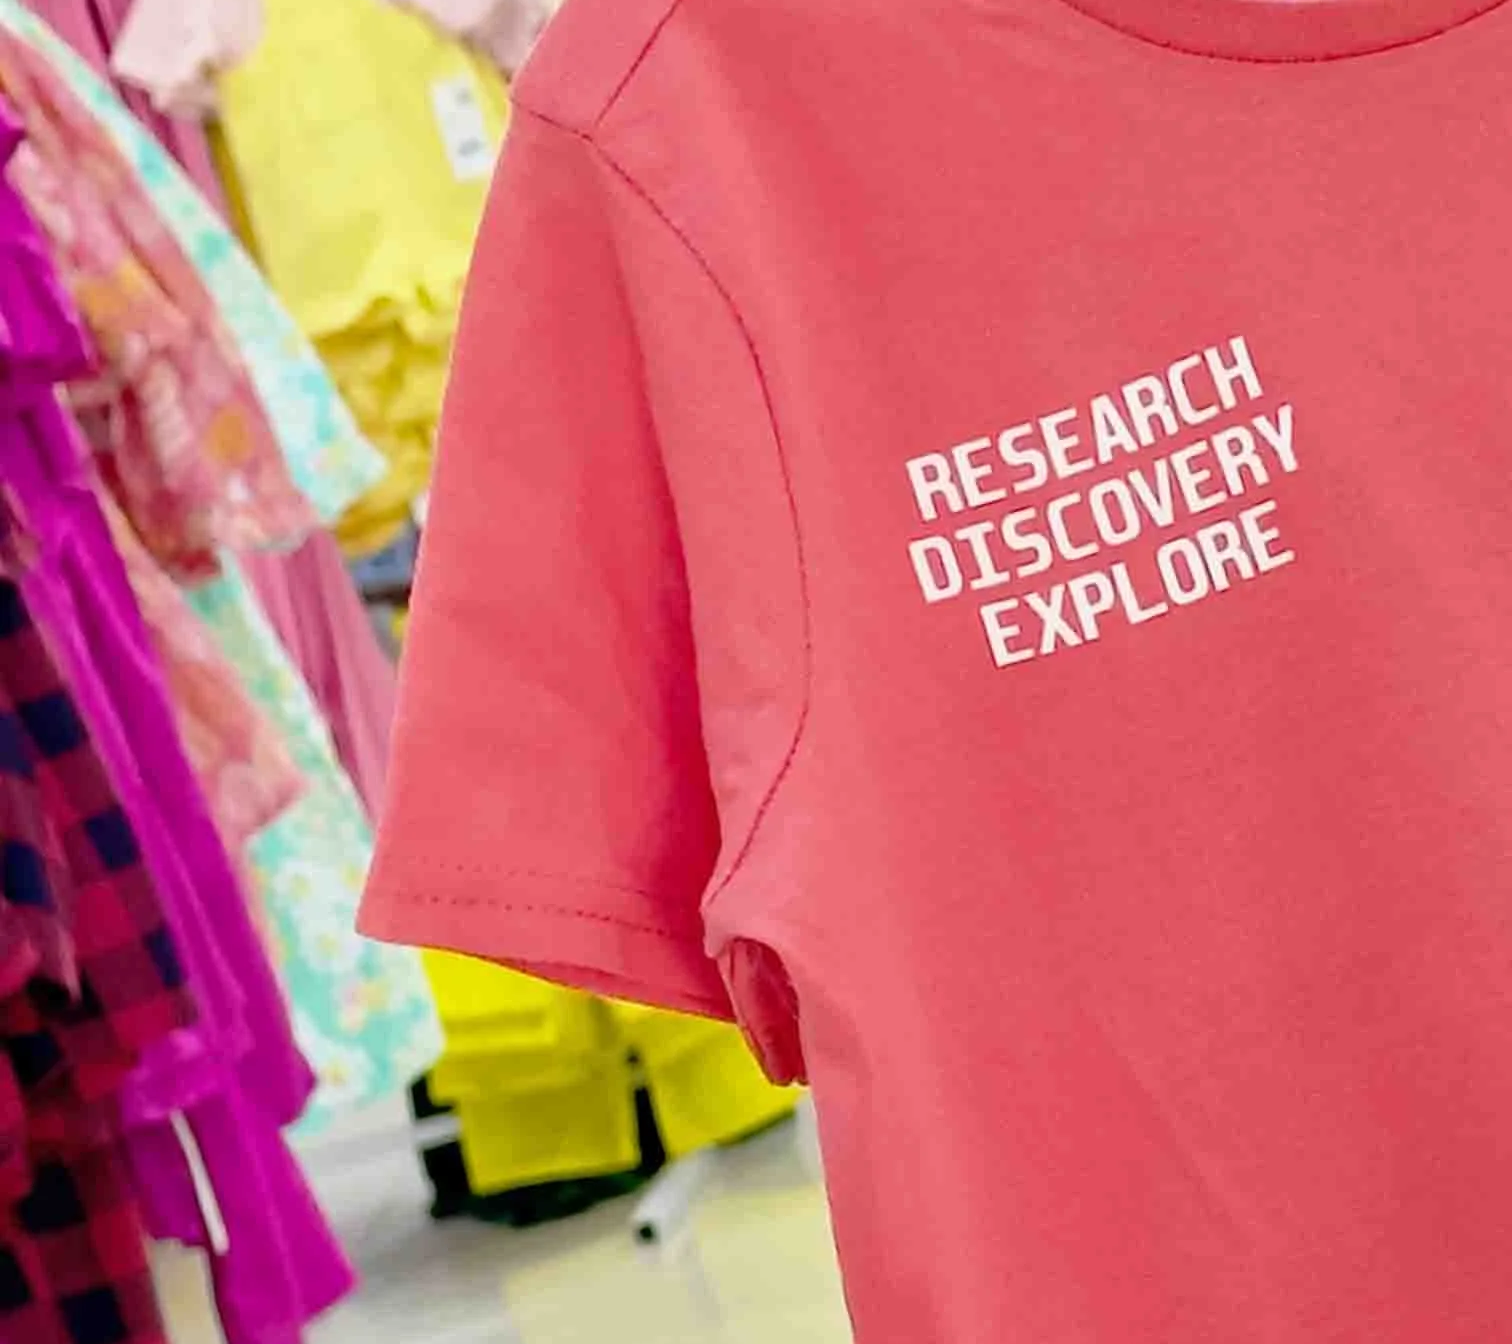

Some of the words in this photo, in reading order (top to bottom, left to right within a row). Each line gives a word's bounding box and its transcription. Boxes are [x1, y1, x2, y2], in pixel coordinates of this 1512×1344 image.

[905, 335, 1263, 522] RESEARCH
[908, 404, 1298, 603] DISCOVERY
[980, 500, 1295, 667] EXPLORE
